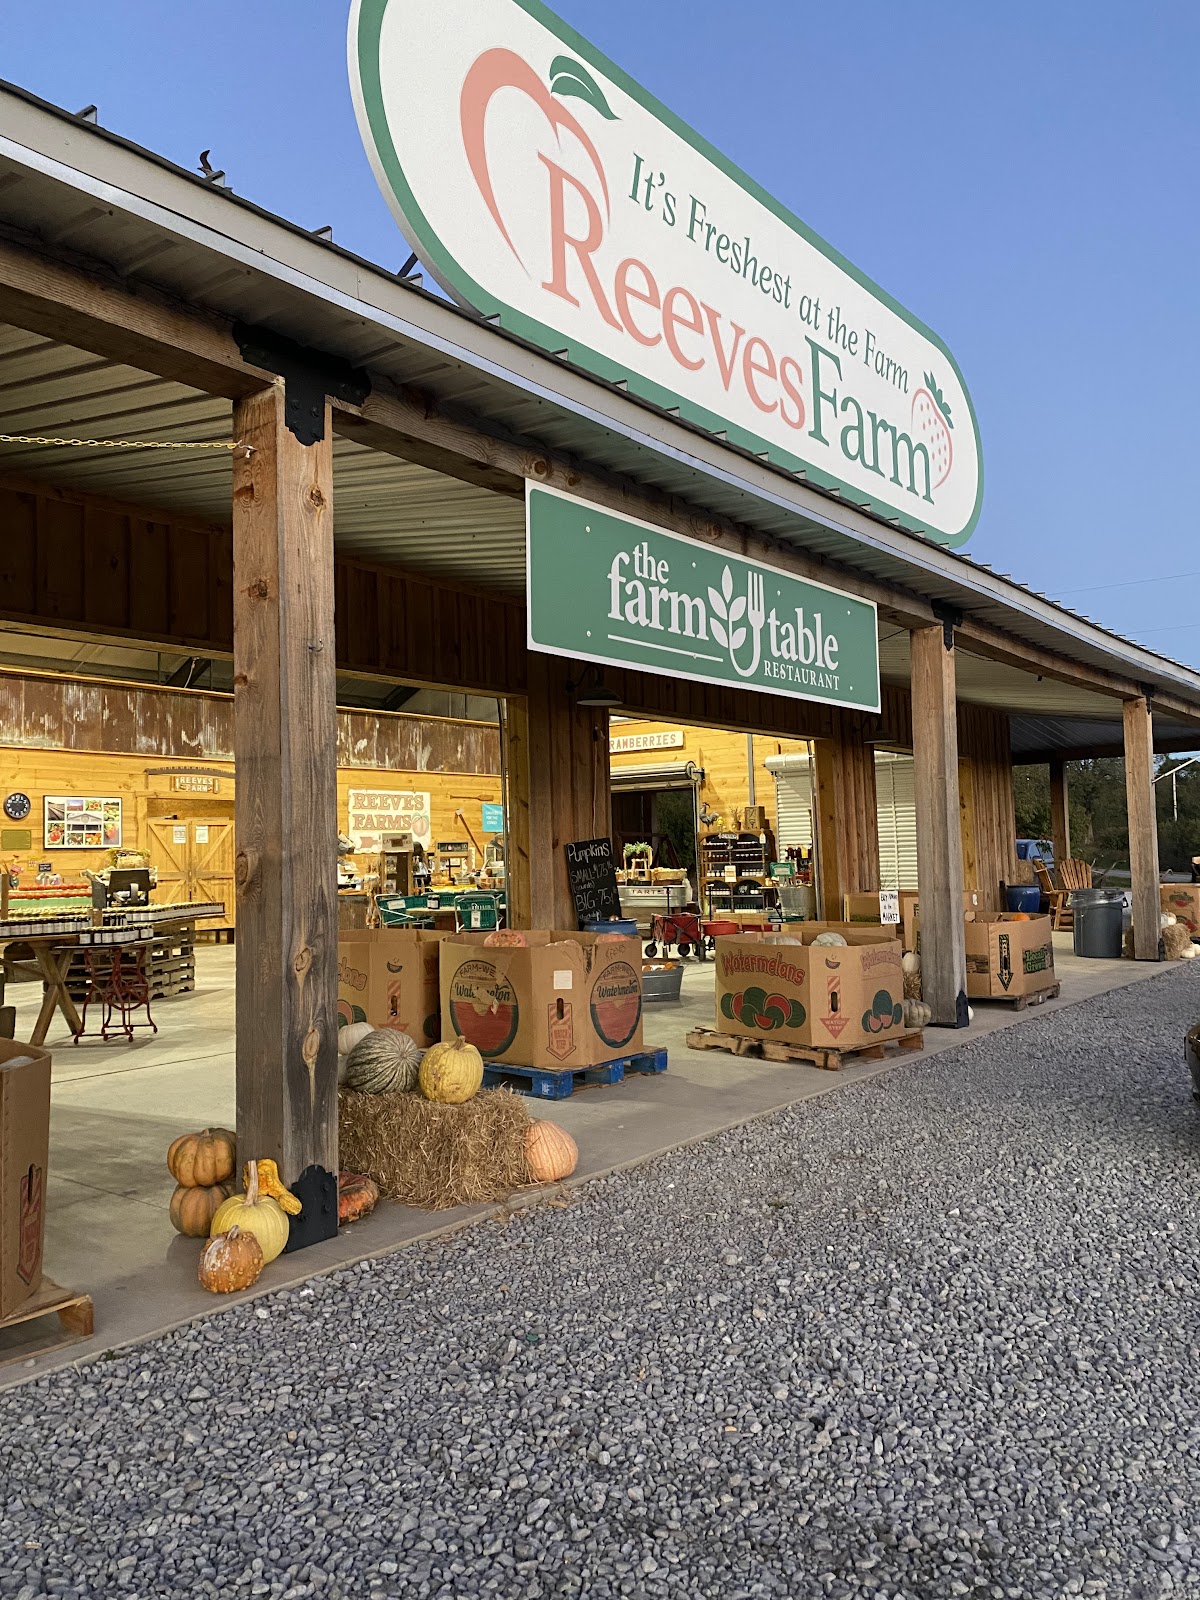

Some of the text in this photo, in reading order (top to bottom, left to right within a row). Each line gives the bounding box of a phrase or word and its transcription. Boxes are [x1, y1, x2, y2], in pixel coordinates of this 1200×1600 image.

[628, 152, 910, 394] It's Freshest at the Farm
[632, 542, 670, 584] the
[607, 552, 839, 671] farm table
[763, 660, 840, 691] RESTAURANT
[180, 776, 213, 785] REEVES
[185, 784, 208, 792] FARM
[352, 793, 424, 811] REEVES
[352, 814, 412, 830] FARMS
[567, 842, 610, 864] Pumpkins
[1024, 948, 1048, 961] Locally
[460, 963, 497, 978] FARM-WE
[722, 949, 806, 986] Watermelons
[596, 979, 638, 999] Watermelon
